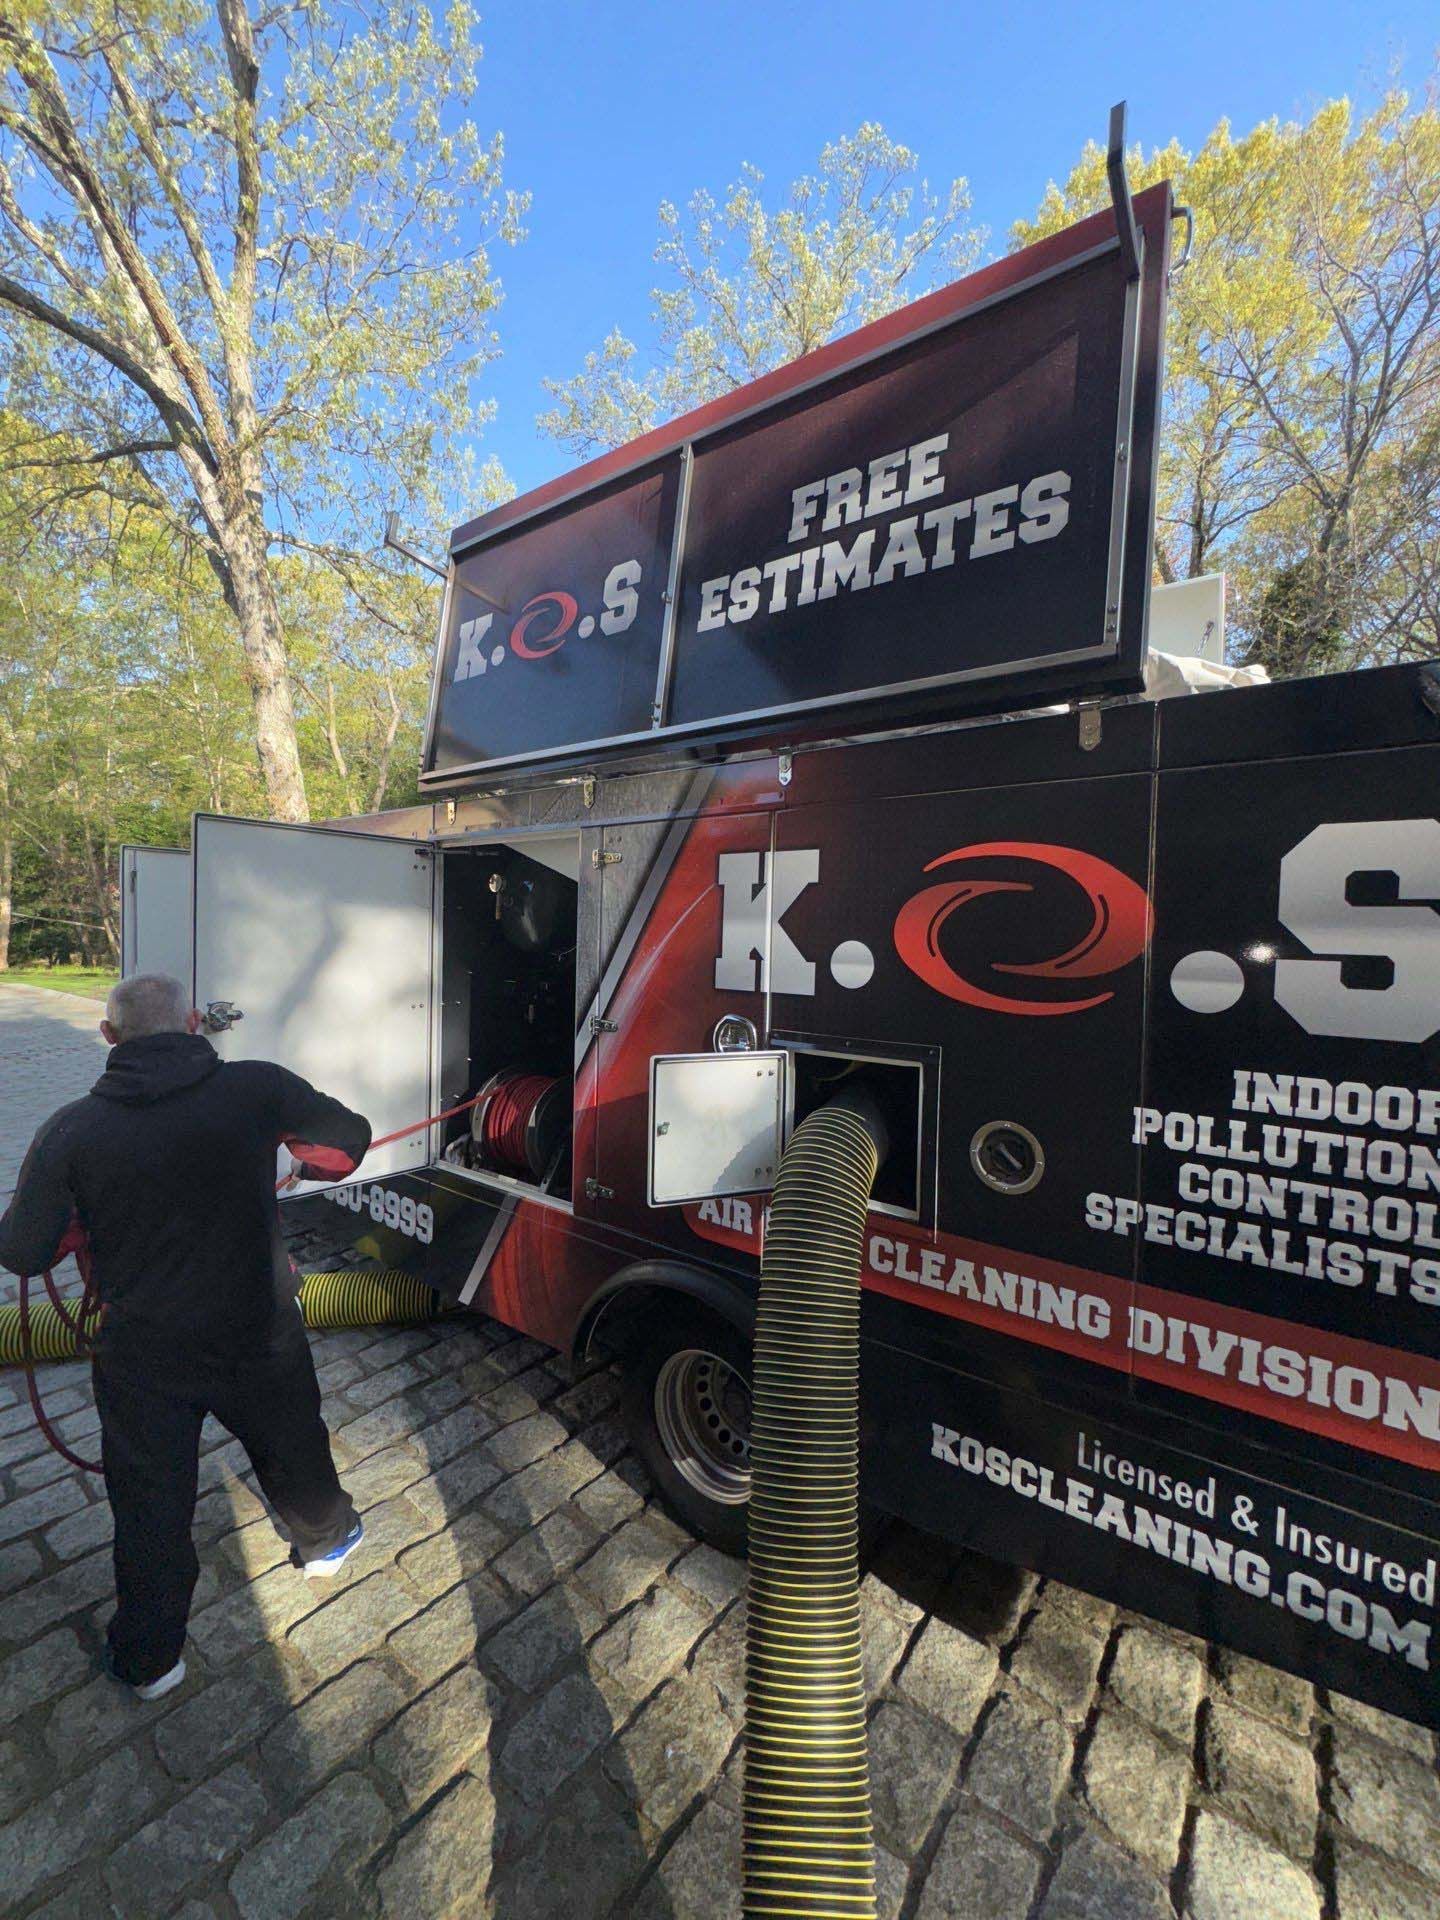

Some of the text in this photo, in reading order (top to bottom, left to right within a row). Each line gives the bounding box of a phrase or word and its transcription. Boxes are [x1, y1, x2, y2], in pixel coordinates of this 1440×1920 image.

[696, 470, 1073, 633] ESTIMATES
[788, 433, 949, 543] FREE
[1132, 1106, 1440, 1193] POLLUTION
[1179, 1163, 1440, 1250] CONTROL
[1085, 1192, 1440, 1307] SPECIALISTS
[697, 1199, 1440, 1442] AIR CLEANING DIVISION
[930, 1423, 1432, 1672] KOSCLEANING.COM
[1078, 1431, 1437, 1608] Licensed & Insured
